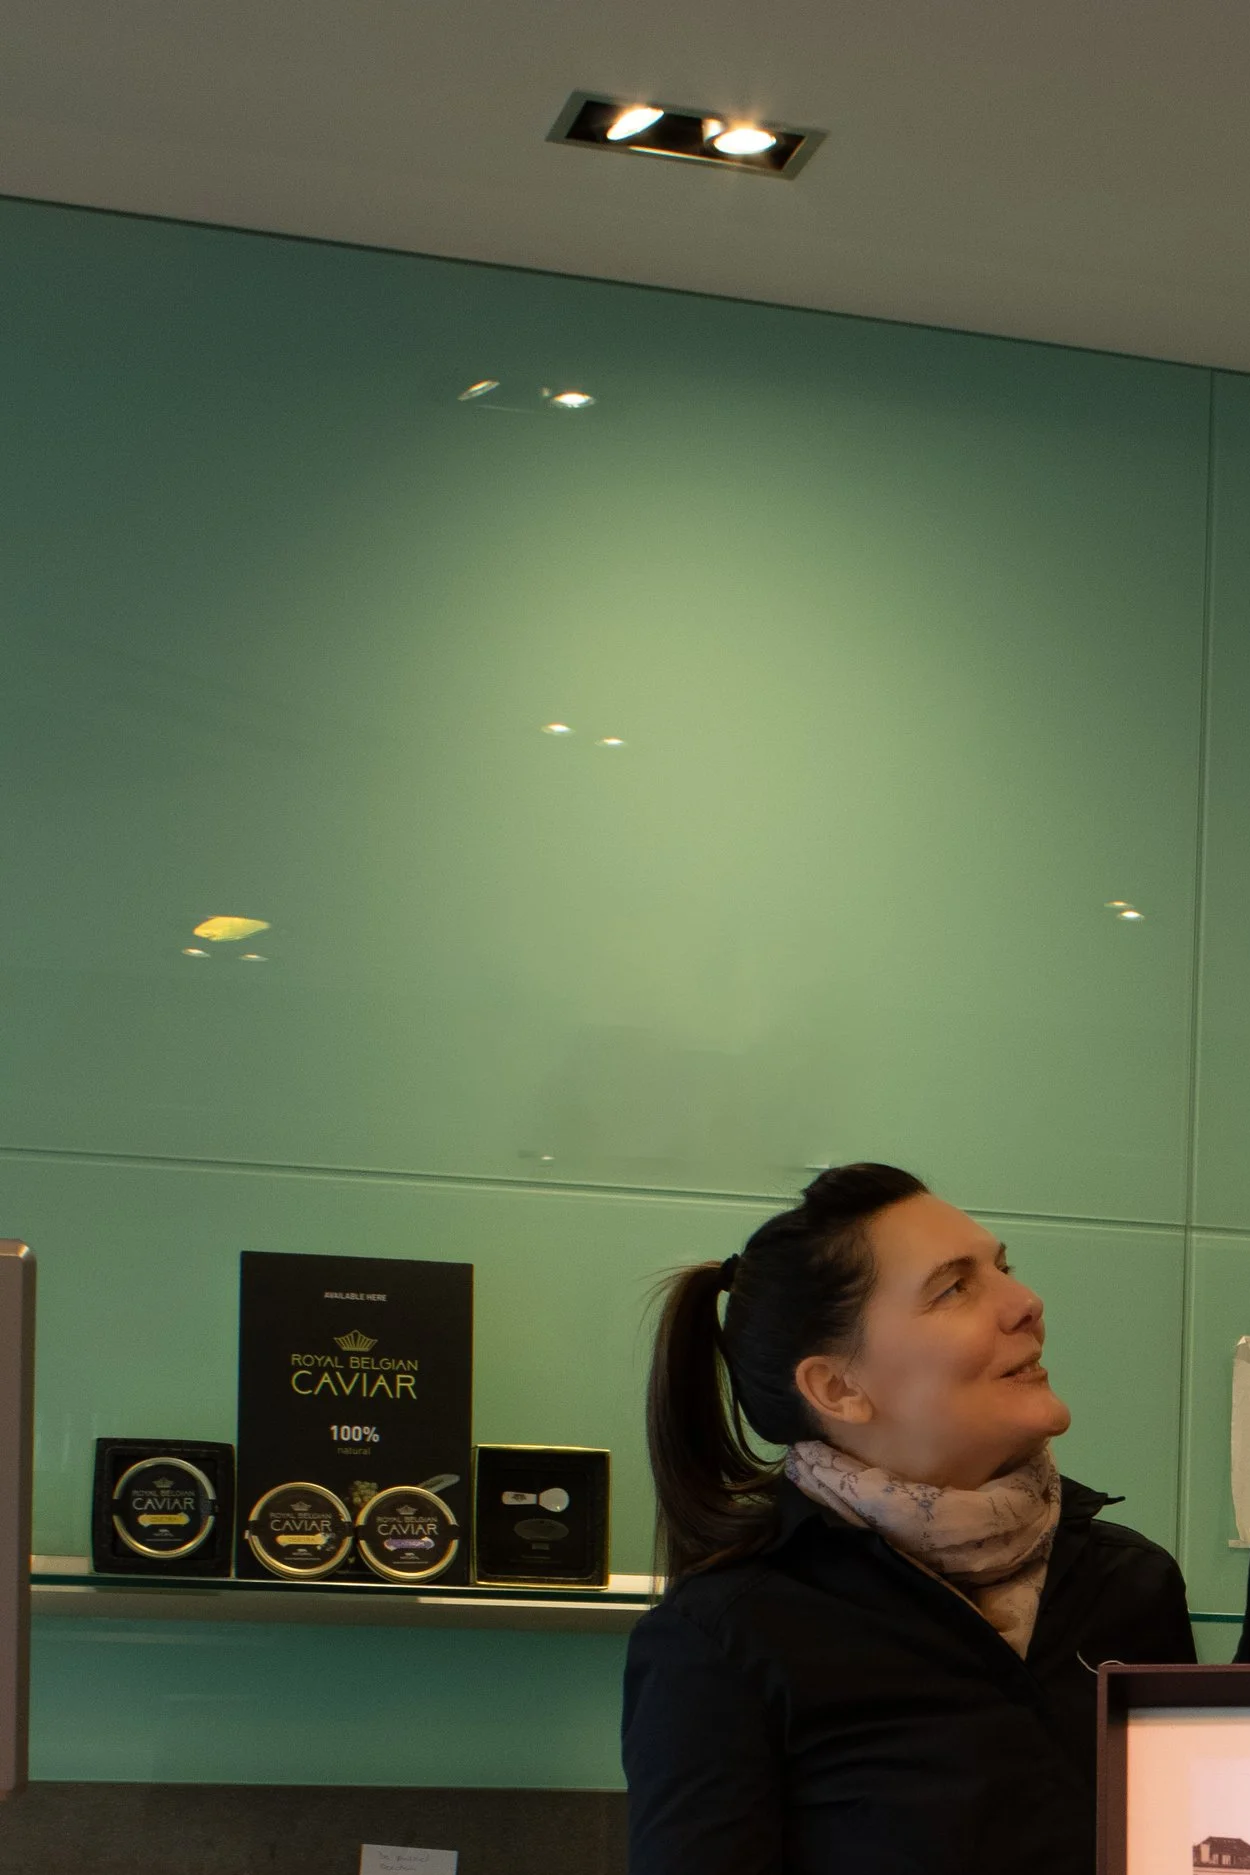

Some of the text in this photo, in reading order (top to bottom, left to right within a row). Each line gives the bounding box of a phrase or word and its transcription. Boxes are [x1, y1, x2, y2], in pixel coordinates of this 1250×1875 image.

[324, 1291, 388, 1302] AVAILABLE HERE
[291, 1353, 418, 1371] ROYAL BELGIAN
[291, 1369, 418, 1400] CAVIAR
[330, 1424, 380, 1443] 100%
[132, 1497, 195, 1510] CAVIAR
[270, 1519, 332, 1532] CAVIAR
[377, 1523, 439, 1535] CAVIAR
